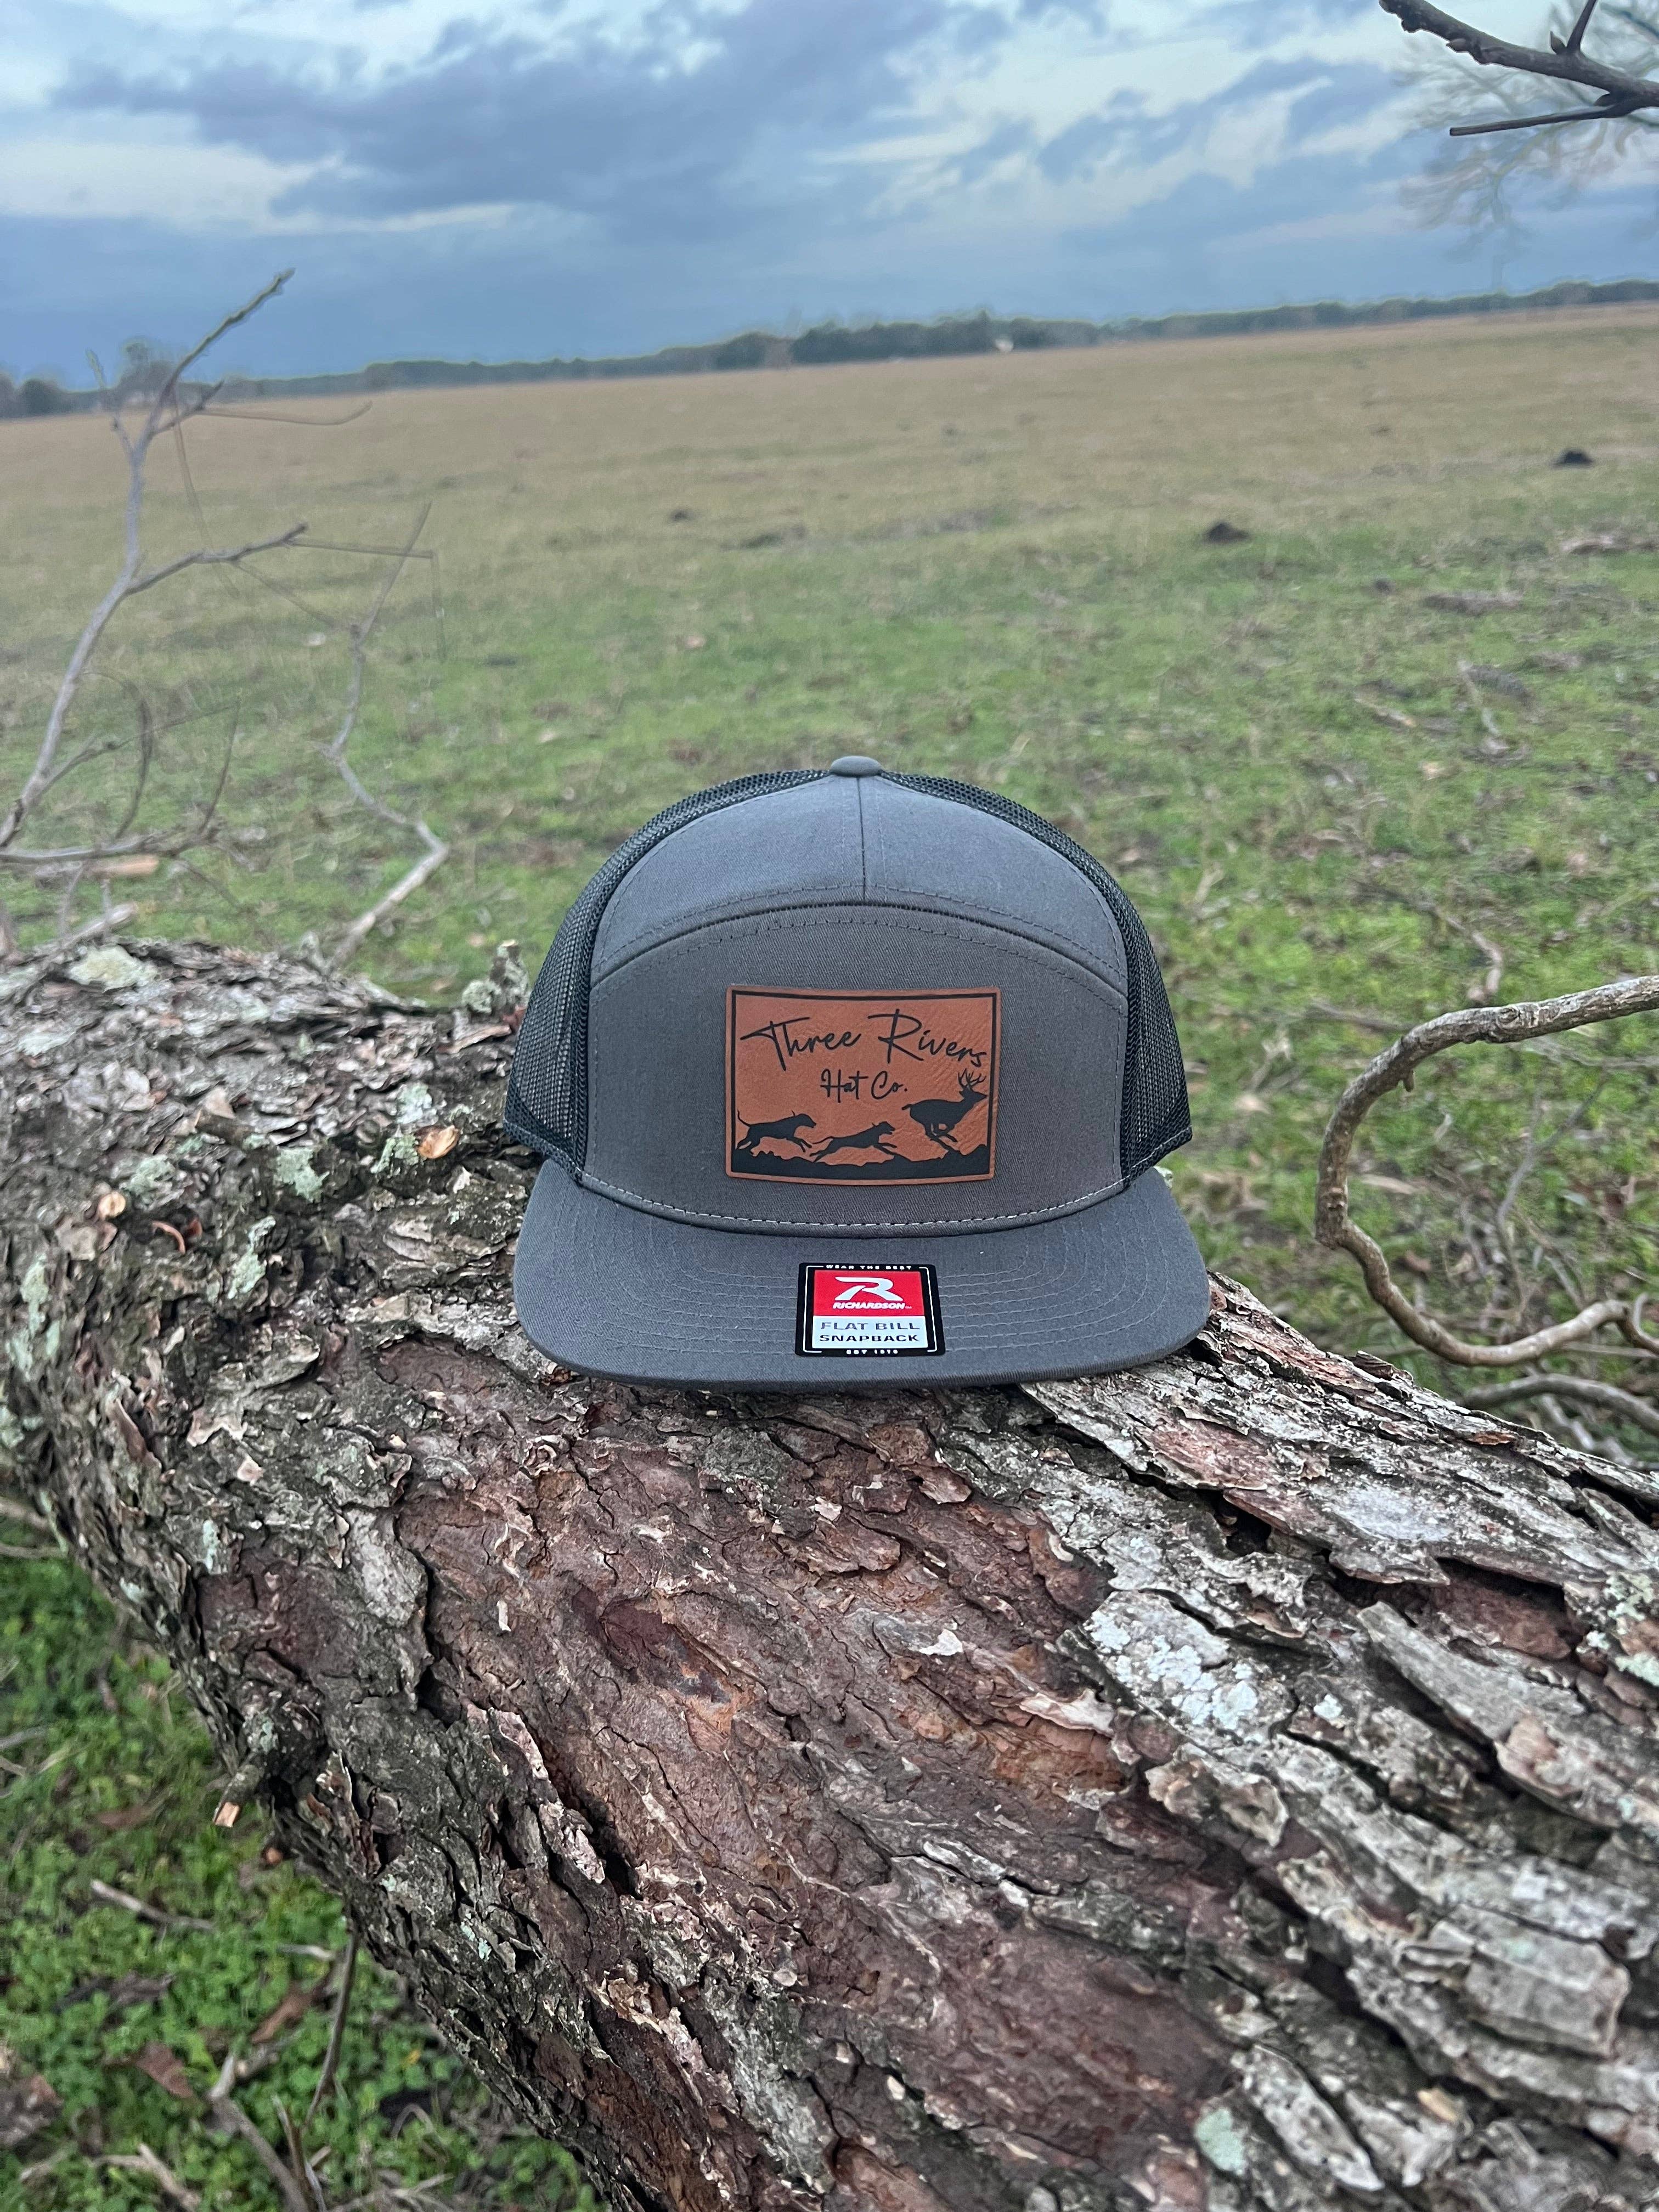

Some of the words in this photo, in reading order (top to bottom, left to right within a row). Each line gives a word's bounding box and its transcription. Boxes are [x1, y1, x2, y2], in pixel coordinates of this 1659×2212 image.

[740, 1017, 861, 1071] Three
[868, 1008, 987, 1067] Rivers
[820, 1069, 868, 1103] Hat
[871, 1071, 908, 1100] Co.
